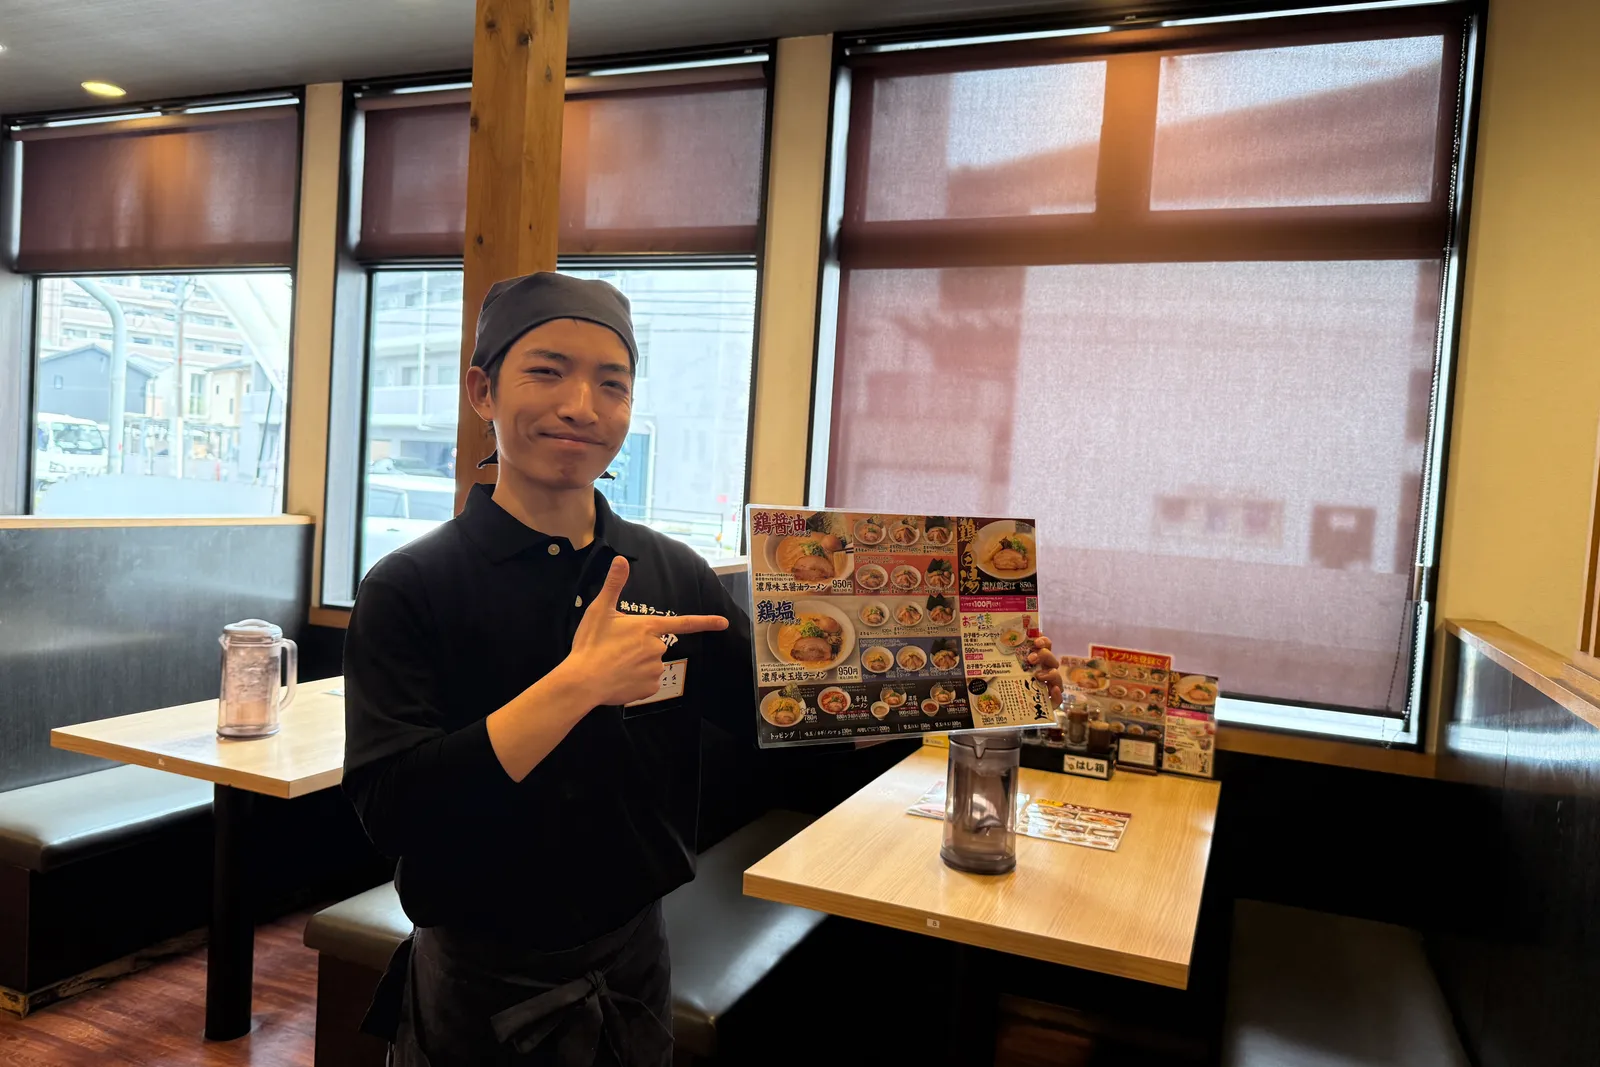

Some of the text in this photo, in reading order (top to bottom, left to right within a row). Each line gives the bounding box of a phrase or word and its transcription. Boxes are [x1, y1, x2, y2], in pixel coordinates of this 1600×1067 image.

[753, 512, 806, 535] 鶏醤油
[756, 582, 828, 592] 濃厚味玉醤油ラーメン
[832, 580, 853, 588] 950円
[757, 600, 796, 623] 鶏塩
[838, 666, 859, 676] 950円
[761, 671, 827, 682] 濃厚味玉塩ラーメン
[770, 730, 796, 740] トッピング
[1075, 760, 1105, 773] はし箱
